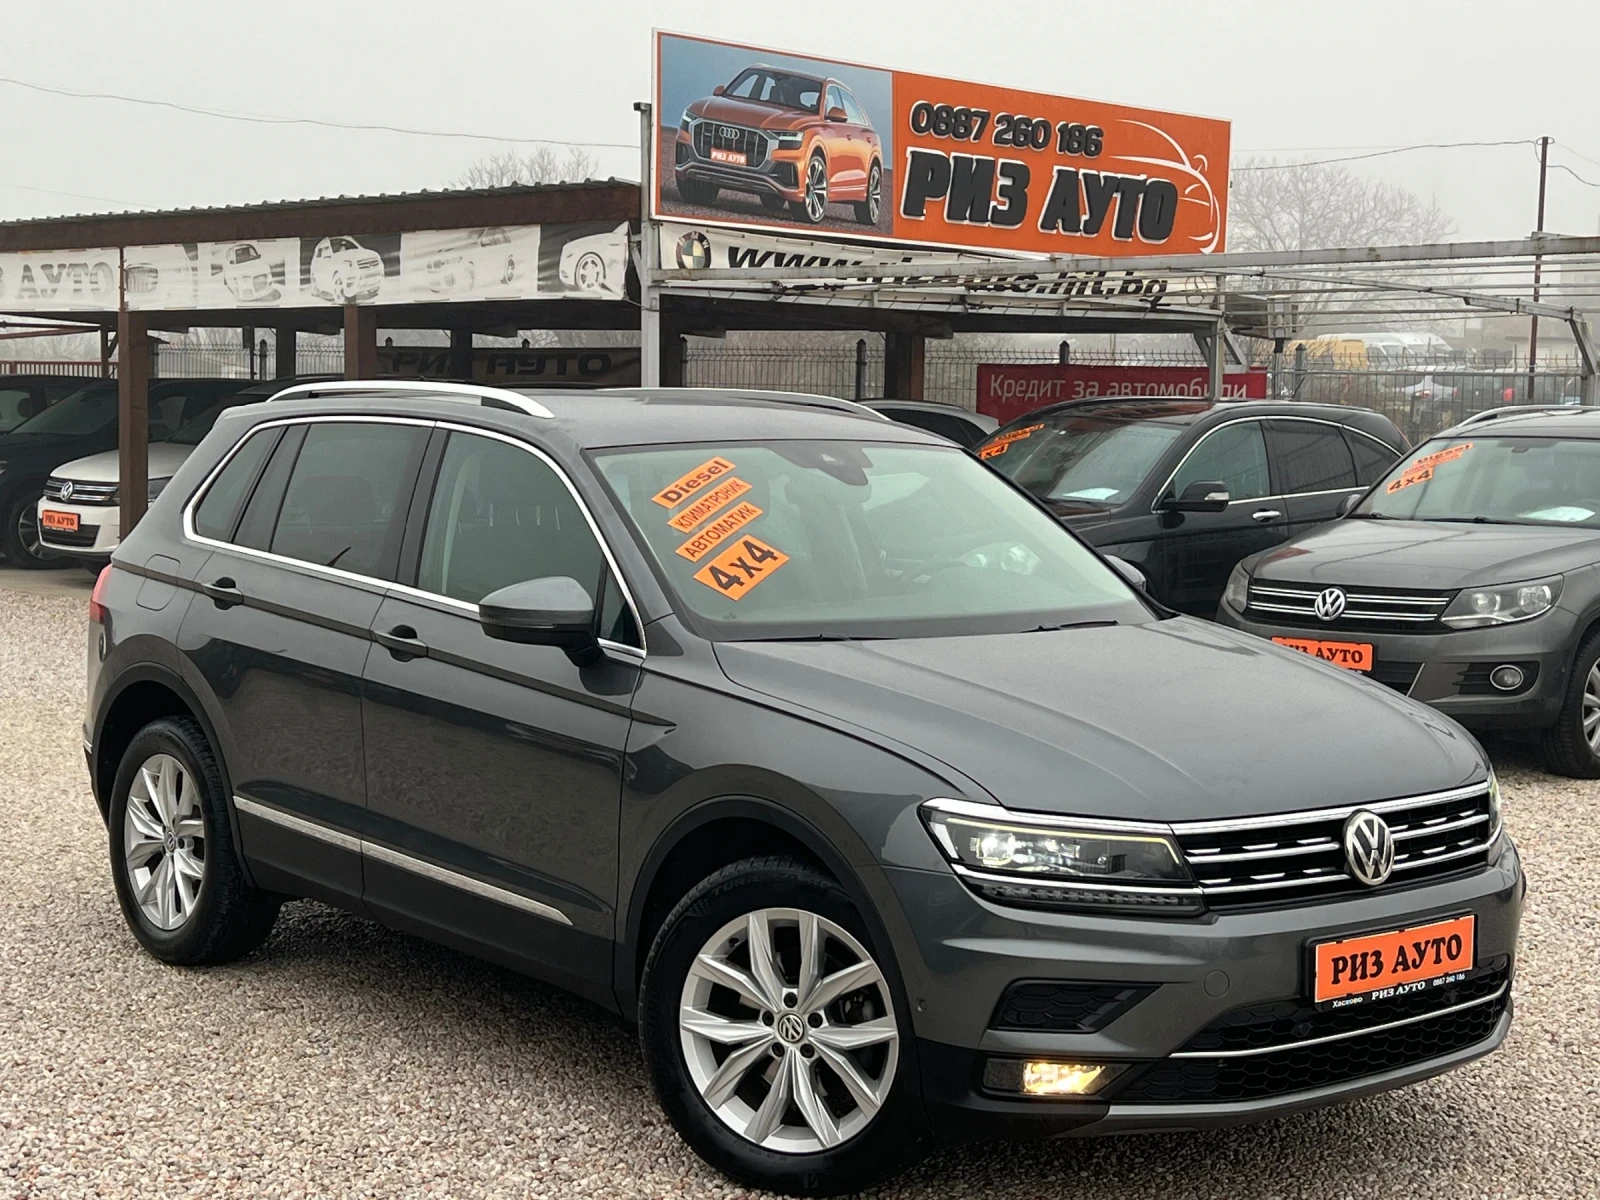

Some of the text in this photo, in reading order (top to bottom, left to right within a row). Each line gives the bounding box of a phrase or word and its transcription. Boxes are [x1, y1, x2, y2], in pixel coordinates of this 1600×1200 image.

[910, 101, 1103, 157] 0887 260 186
[901, 147, 1178, 244] РИЗ АУТО
[15, 262, 114, 299] АУТО
[487, 353, 612, 377] АУТО
[989, 374, 1065, 401] Кредит
[1070, 380, 1099, 399] за
[661, 460, 729, 504] Diesel
[675, 479, 747, 530] КЛИМАТРОНИК
[684, 504, 757, 559] АВТОМАТИК
[1331, 933, 1463, 986] РИЗ АУТО
[1332, 996, 1364, 1009] Хасково
[1371, 988, 1395, 1001] РИЗ
[1395, 980, 1426, 996] АУТО
